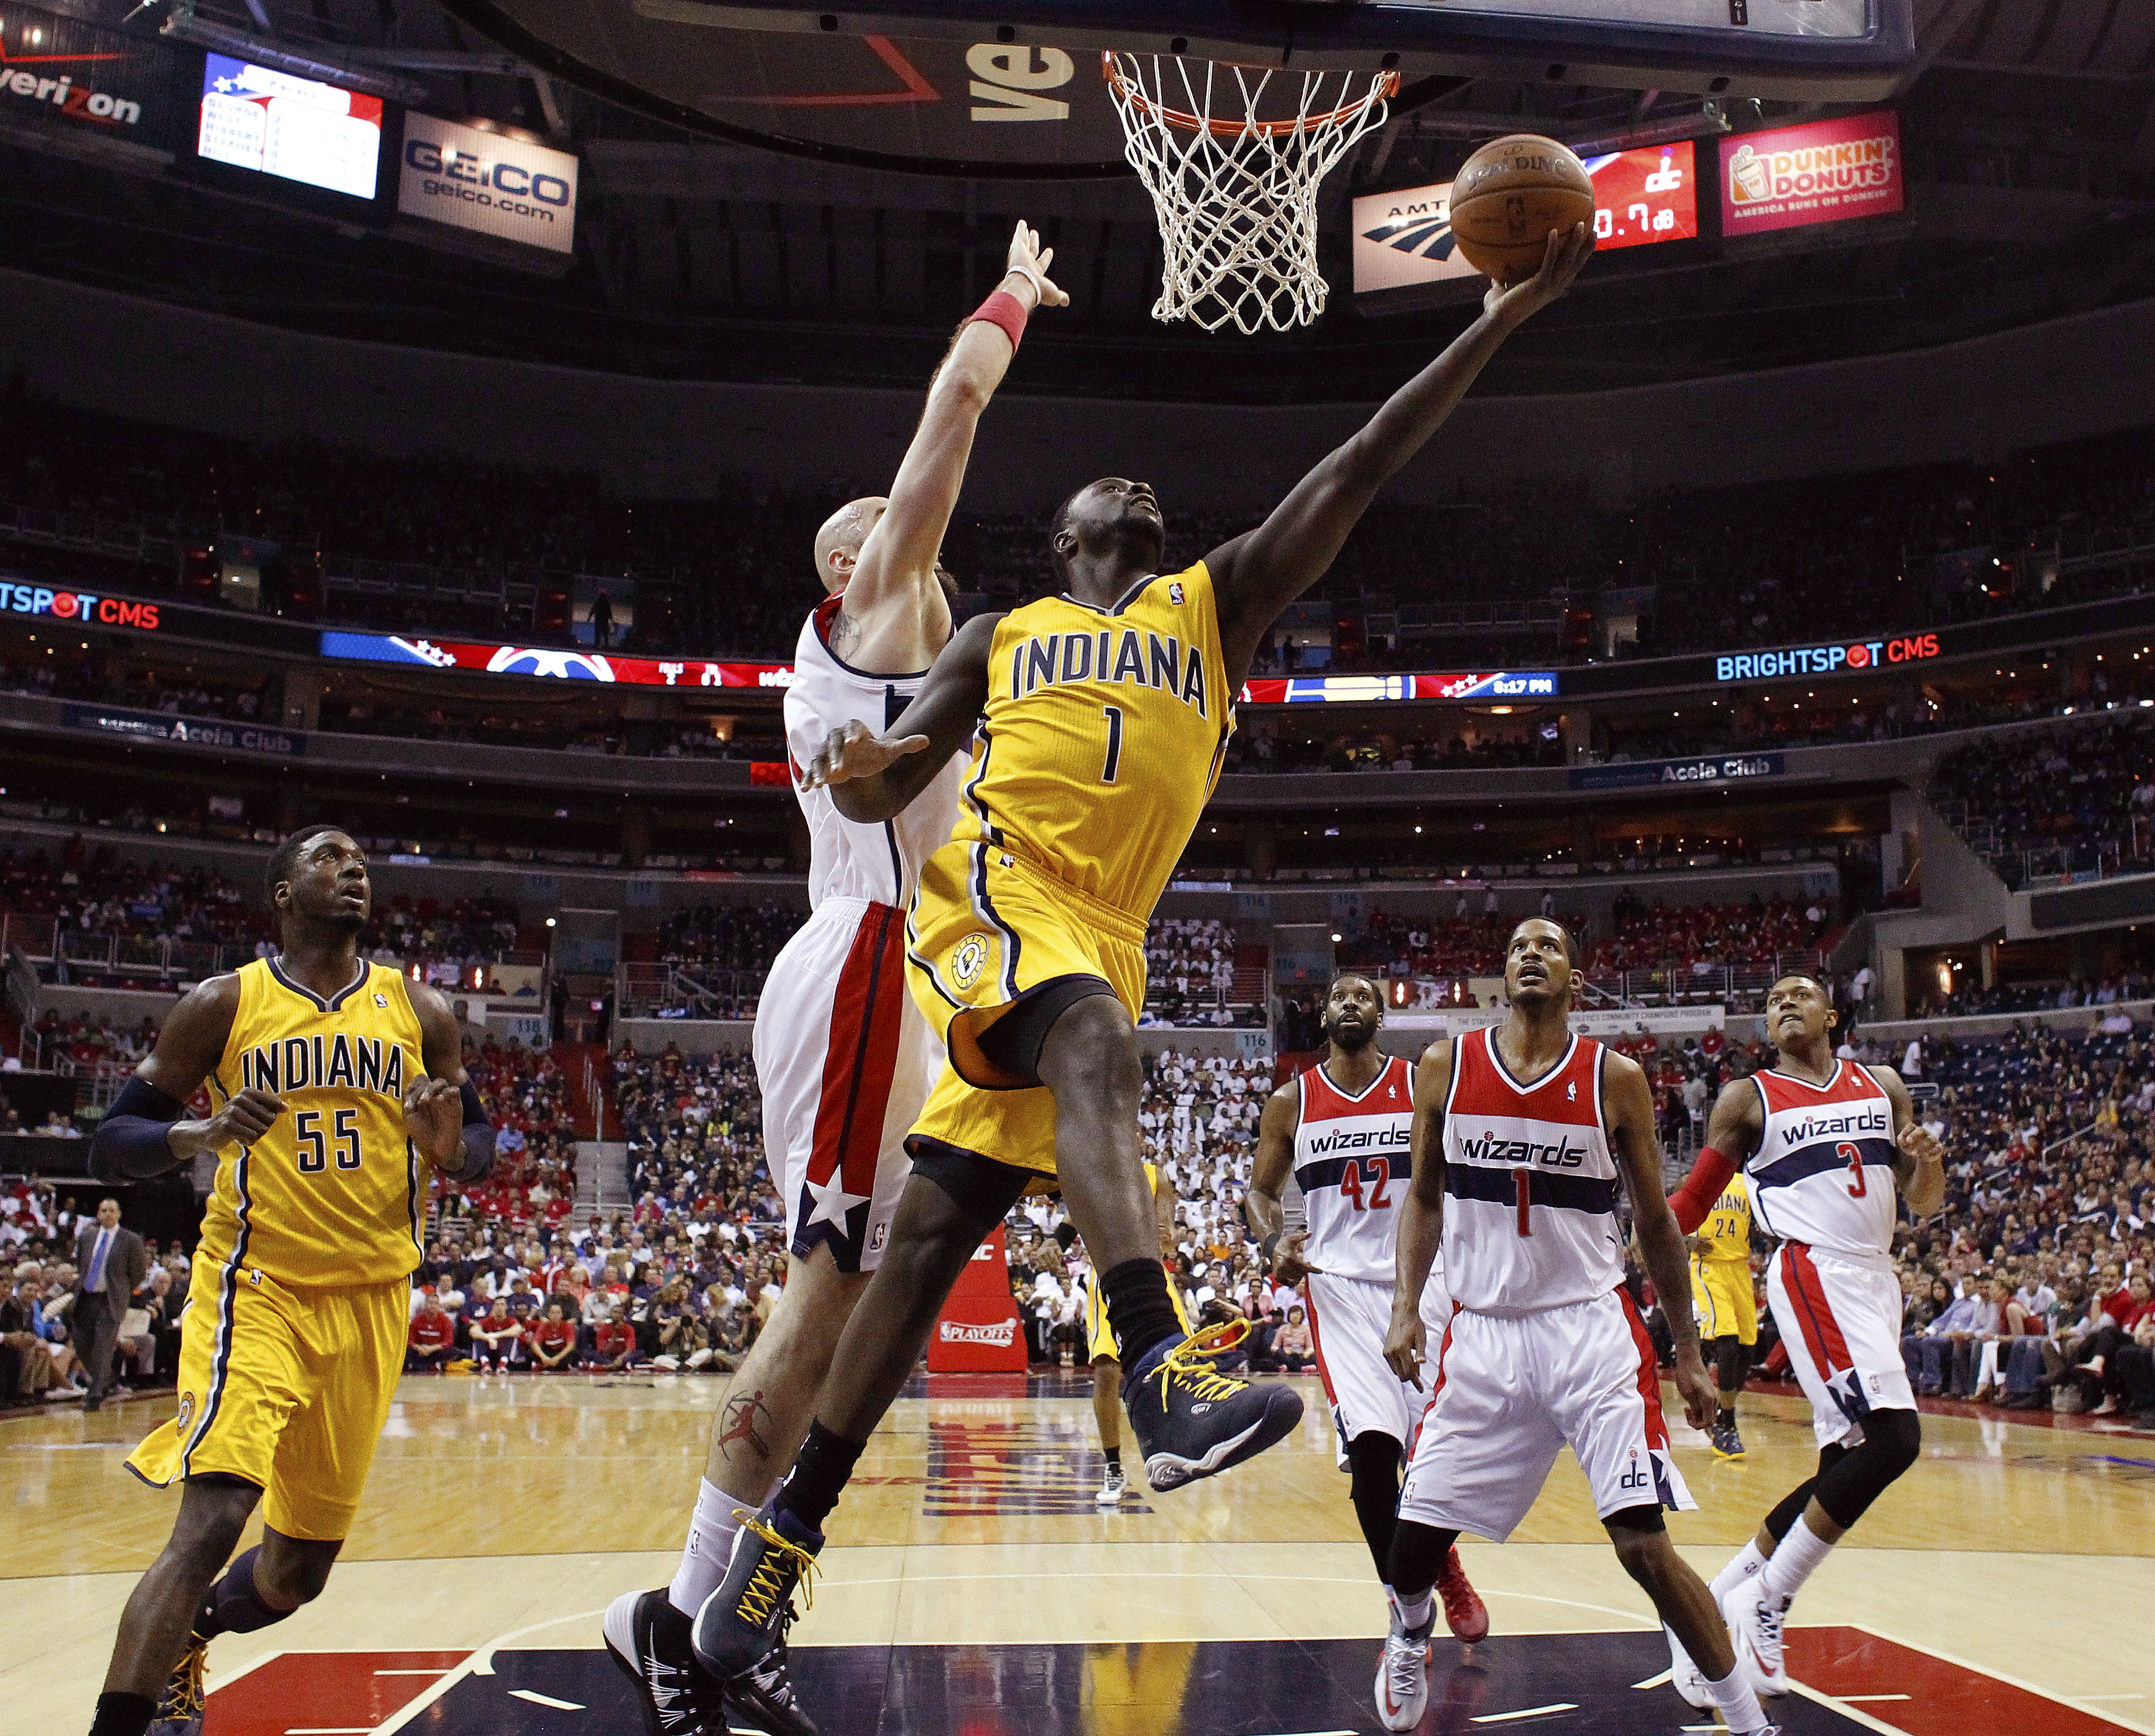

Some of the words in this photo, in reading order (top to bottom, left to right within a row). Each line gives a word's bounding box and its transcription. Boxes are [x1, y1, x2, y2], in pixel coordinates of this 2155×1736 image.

[405, 140, 569, 206] GEICO
[1775, 163, 1887, 195] DONUTS
[424, 179, 553, 222] geico.com
[1734, 204, 1785, 219] AMERICA
[1788, 199, 1818, 210] RUNS
[1822, 196, 1840, 206] ON
[99, 598, 159, 629] CMS
[1011, 629, 1209, 722] INDIANA
[1717, 642, 1883, 681] BRIGHTSPOT
[1887, 633, 1939, 662] CMS
[1529, 679, 1552, 693] PM
[1101, 705, 1124, 785] 1
[1723, 758, 1770, 777] Club
[1244, 1034, 1266, 1046] 116
[239, 1034, 404, 1099] INDIANA
[295, 1108, 362, 1173] 55
[1310, 1121, 1411, 1154] wizards
[1782, 1105, 1887, 1145] wizards
[1459, 1131, 1588, 1167] wizards
[1341, 1157, 1392, 1211] 42
[1835, 1142, 1866, 1198] 3
[1511, 1167, 1533, 1238] 1
[1716, 1218, 1736, 1238] 24
[949, 1326, 1014, 1341] PLAYOFFS
[1621, 1459, 1647, 1489] dc
